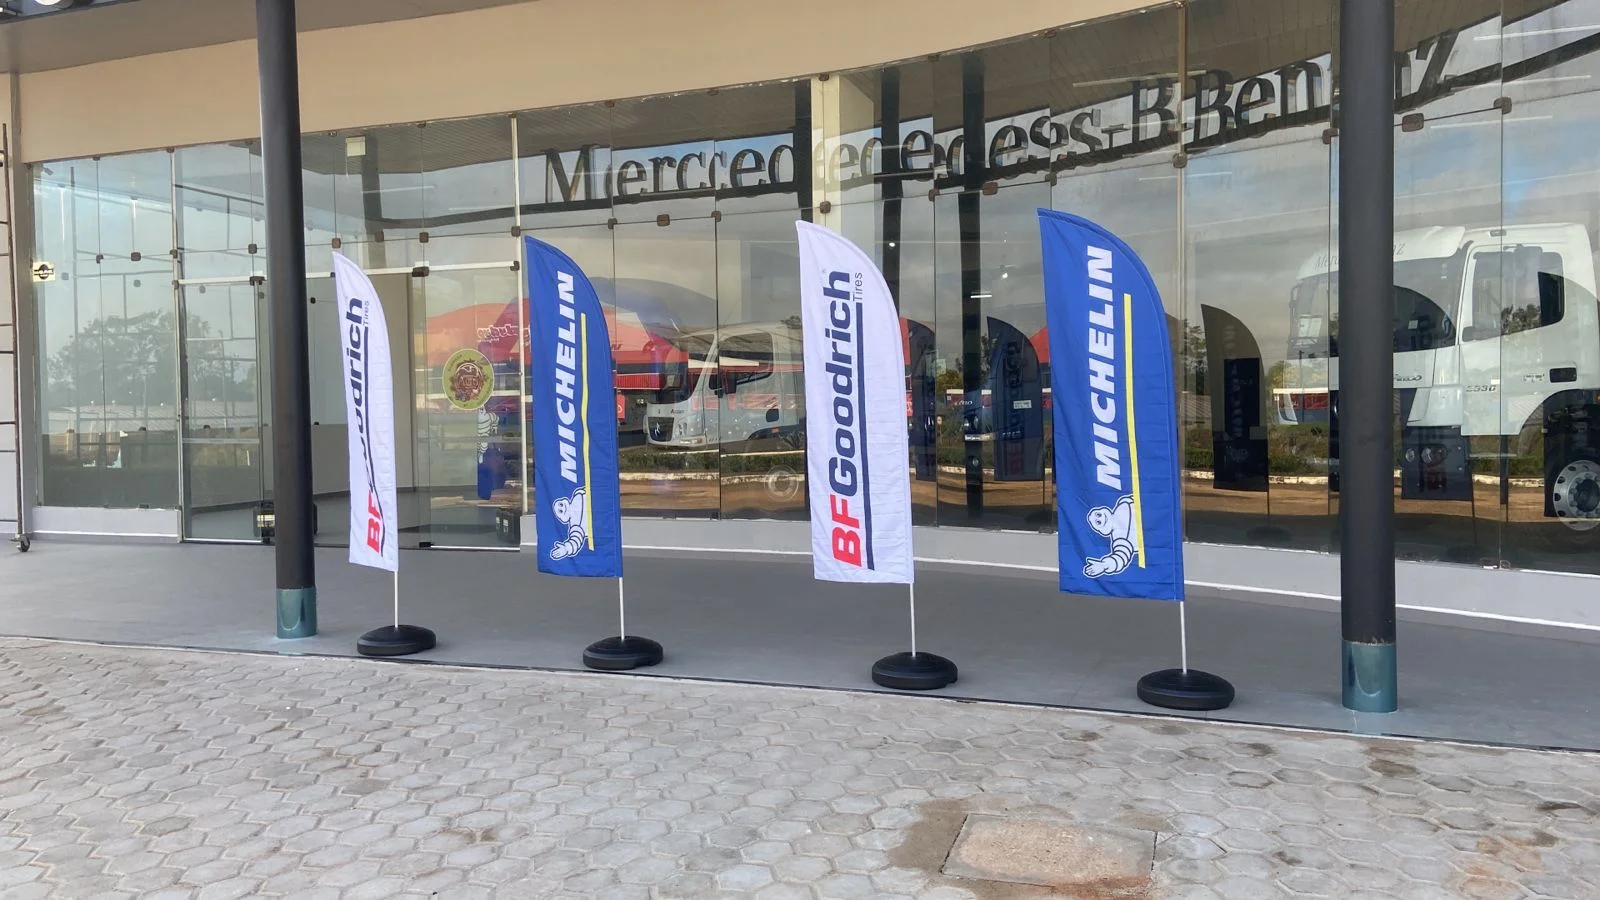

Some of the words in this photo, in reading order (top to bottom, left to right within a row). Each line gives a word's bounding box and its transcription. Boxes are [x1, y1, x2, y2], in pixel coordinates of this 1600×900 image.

[555, 271, 577, 483] MICHELIN
[853, 272, 862, 302] Tires
[1087, 245, 1122, 490] MICHELIN
[823, 270, 862, 567] BFGoodrich
